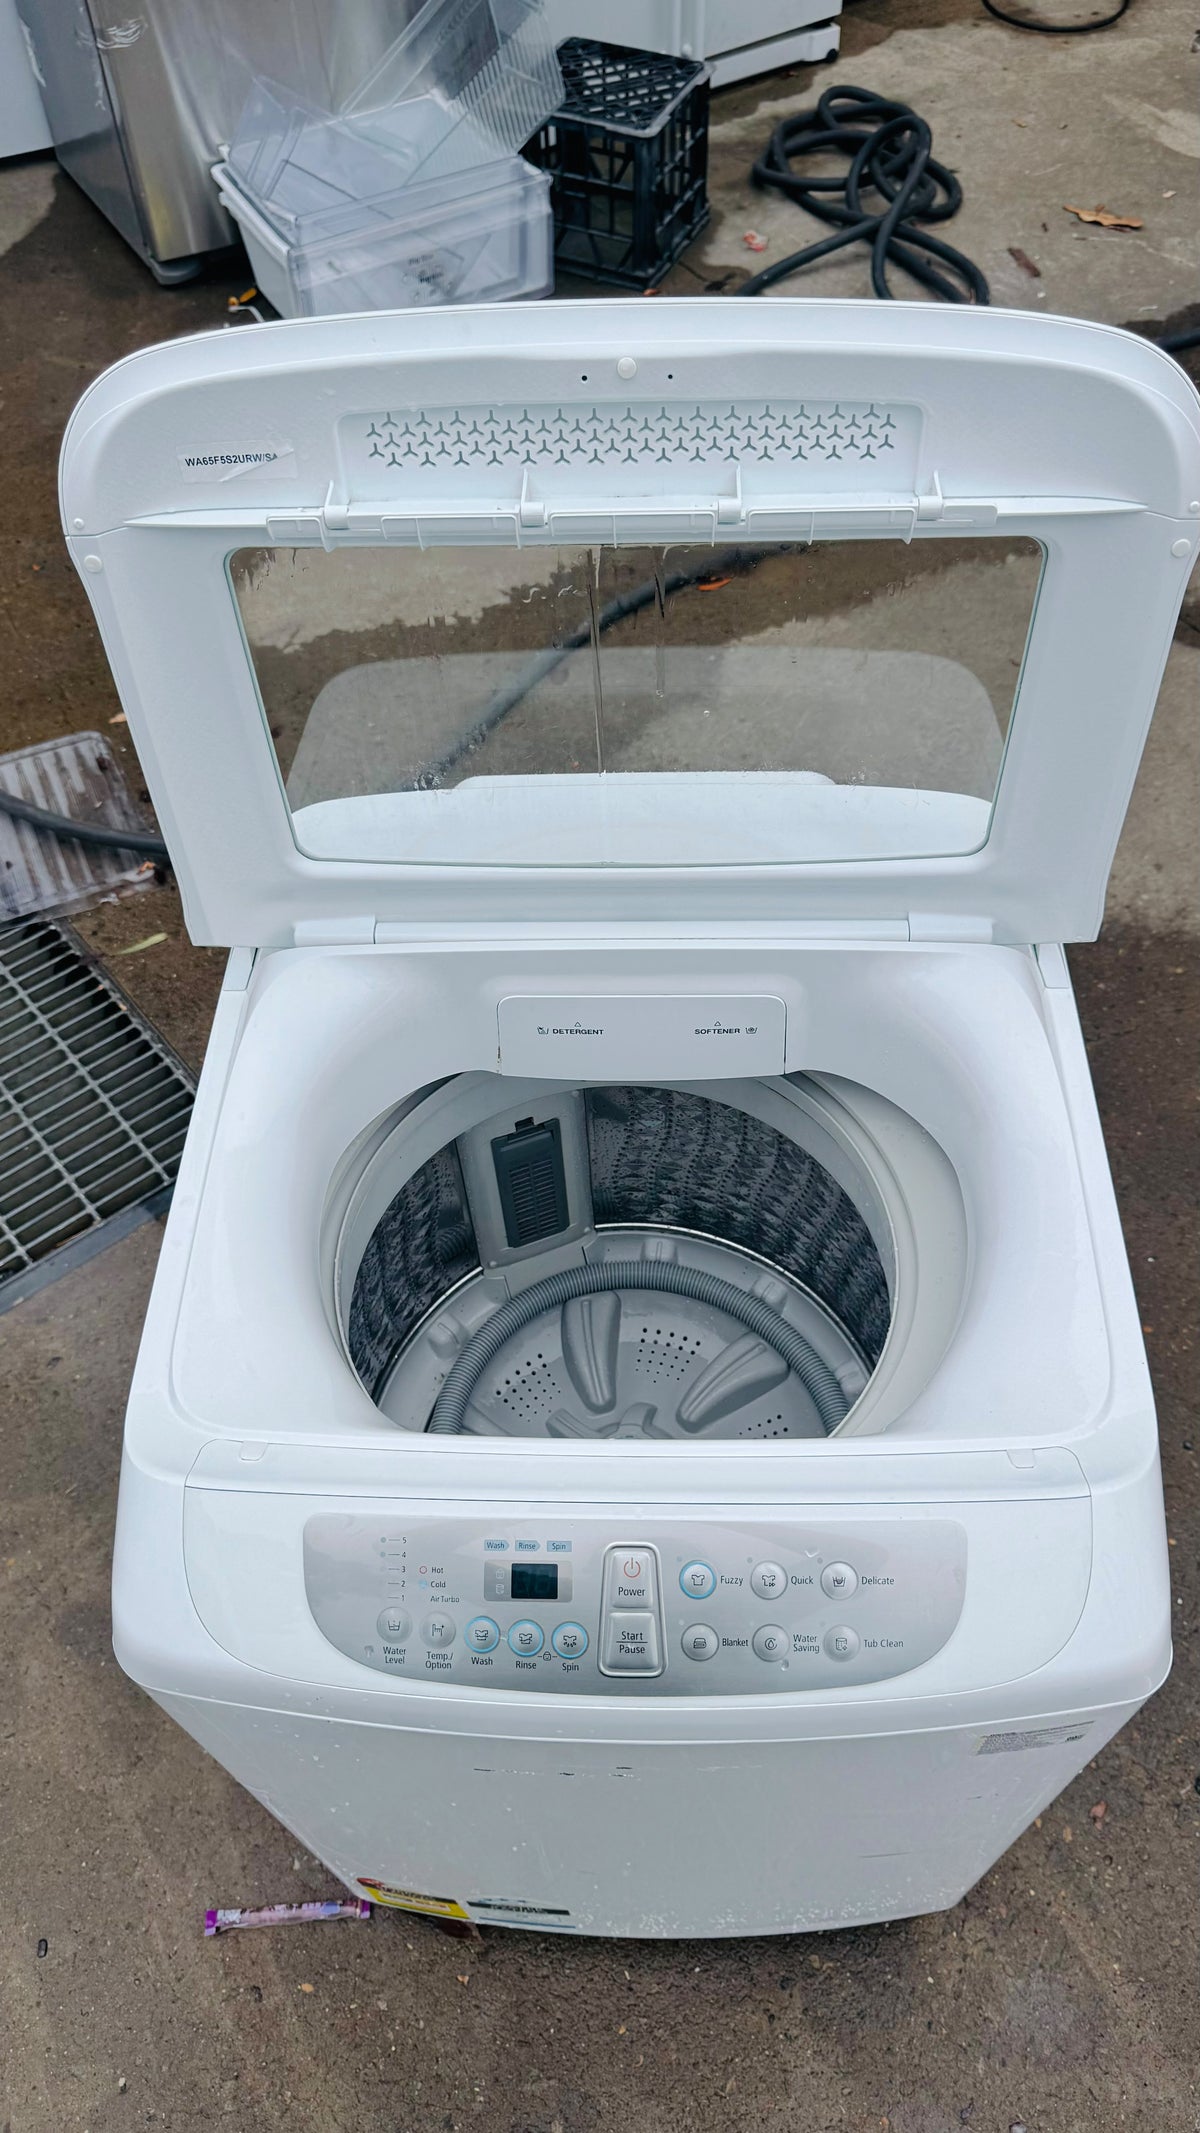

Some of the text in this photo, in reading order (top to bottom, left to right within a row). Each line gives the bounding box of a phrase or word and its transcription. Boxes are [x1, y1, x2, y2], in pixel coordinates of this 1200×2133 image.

[486, 1541, 505, 1550] Wash
[518, 1542, 536, 1550] Rinse
[551, 1542, 567, 1551] Spin
[431, 1566, 444, 1574] Hot
[401, 1580, 406, 1588] 2
[430, 1580, 446, 1588] Cold
[720, 1575, 744, 1586] Fuzzy
[790, 1575, 814, 1586] Quick
[861, 1576, 895, 1586] Delicate
[618, 1586, 646, 1596] Power
[621, 1631, 643, 1641] Start
[793, 1634, 818, 1643] Water
[721, 1637, 749, 1647] Blanket
[864, 1638, 904, 1648] Tub Clean
[383, 1646, 406, 1656] Water
[619, 1644, 646, 1654] Pause
[793, 1643, 820, 1655] Saving
[385, 1655, 405, 1664] Level
[426, 1650, 454, 1661] Temp./
[425, 1660, 452, 1670] Option
[471, 1656, 493, 1666] Wash
[515, 1660, 537, 1670] Rinse
[562, 1662, 580, 1672] Spin
